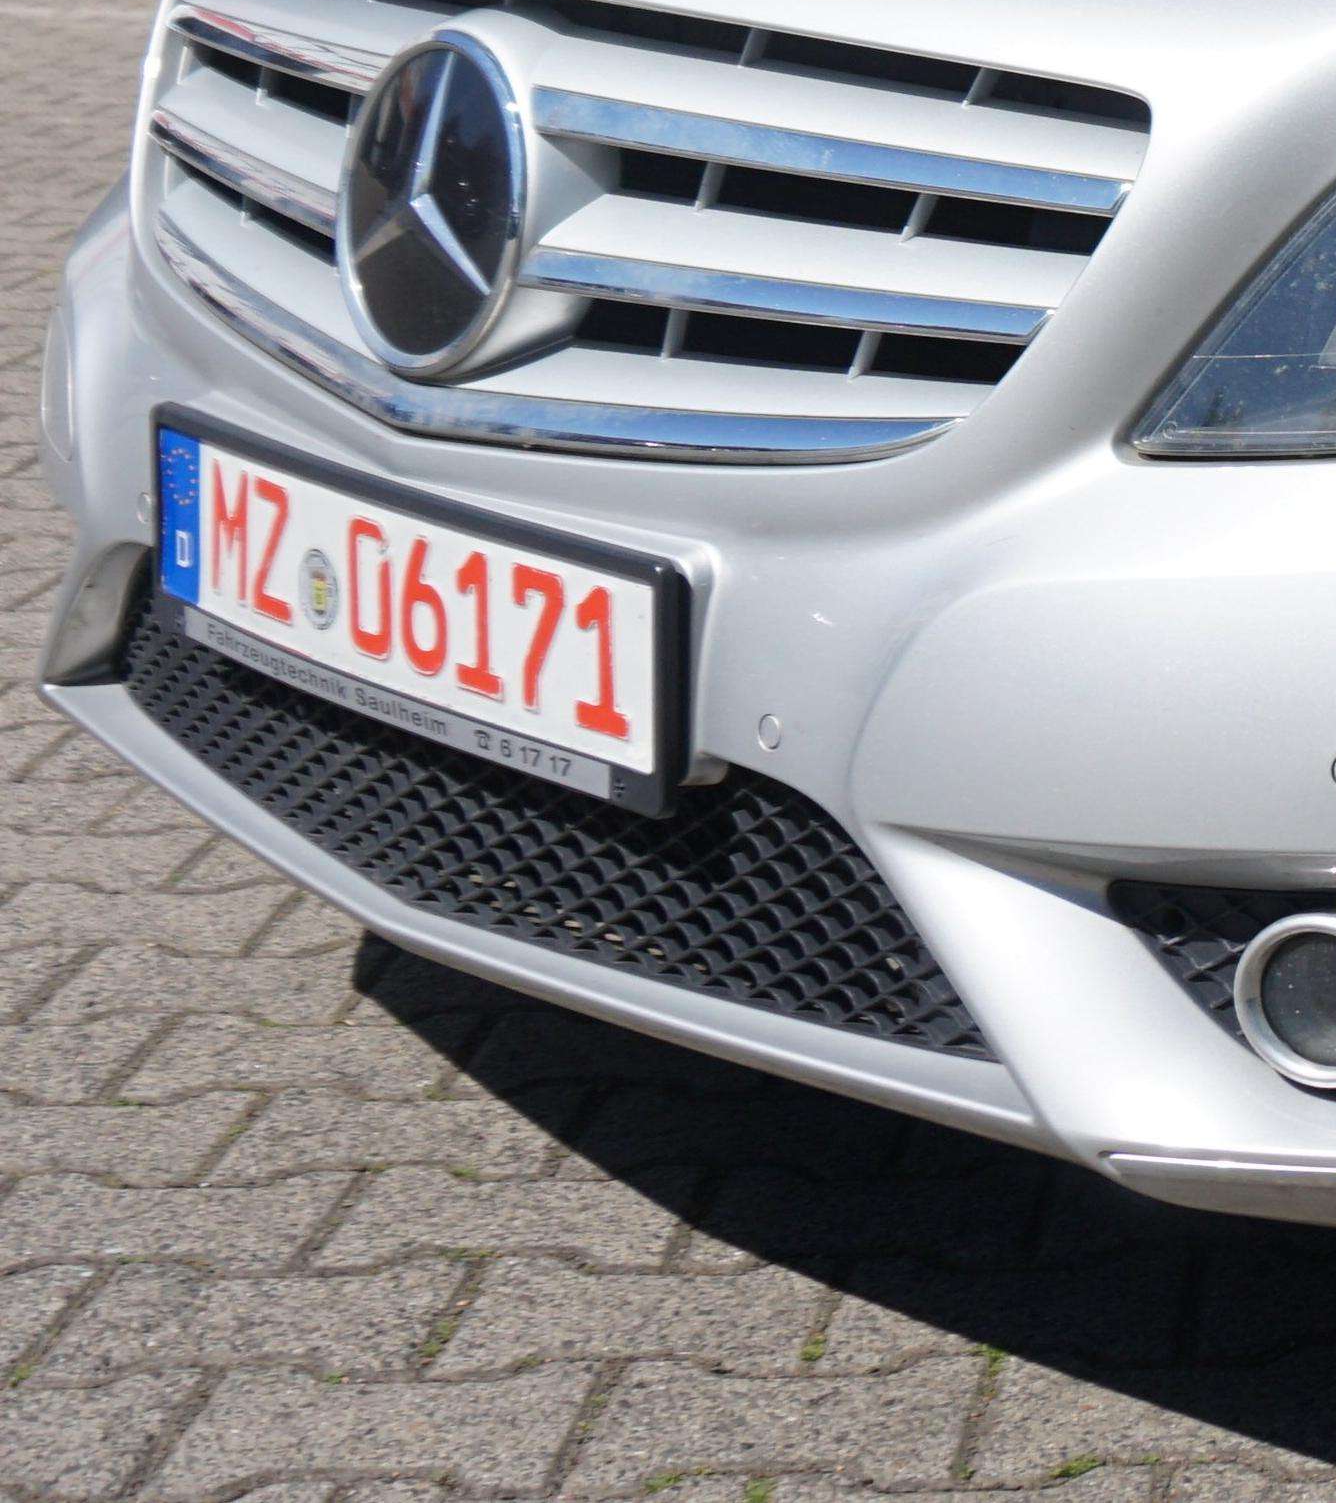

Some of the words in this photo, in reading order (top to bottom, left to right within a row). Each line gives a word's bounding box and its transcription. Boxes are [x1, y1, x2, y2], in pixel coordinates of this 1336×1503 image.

[175, 529, 193, 569] D
[211, 459, 293, 625] MZ
[346, 516, 631, 742] 06171
[206, 623, 347, 699] Fahrzeugtechnik
[354, 687, 450, 737] Saulheim
[520, 746, 542, 768] 17
[548, 755, 572, 778] 17
